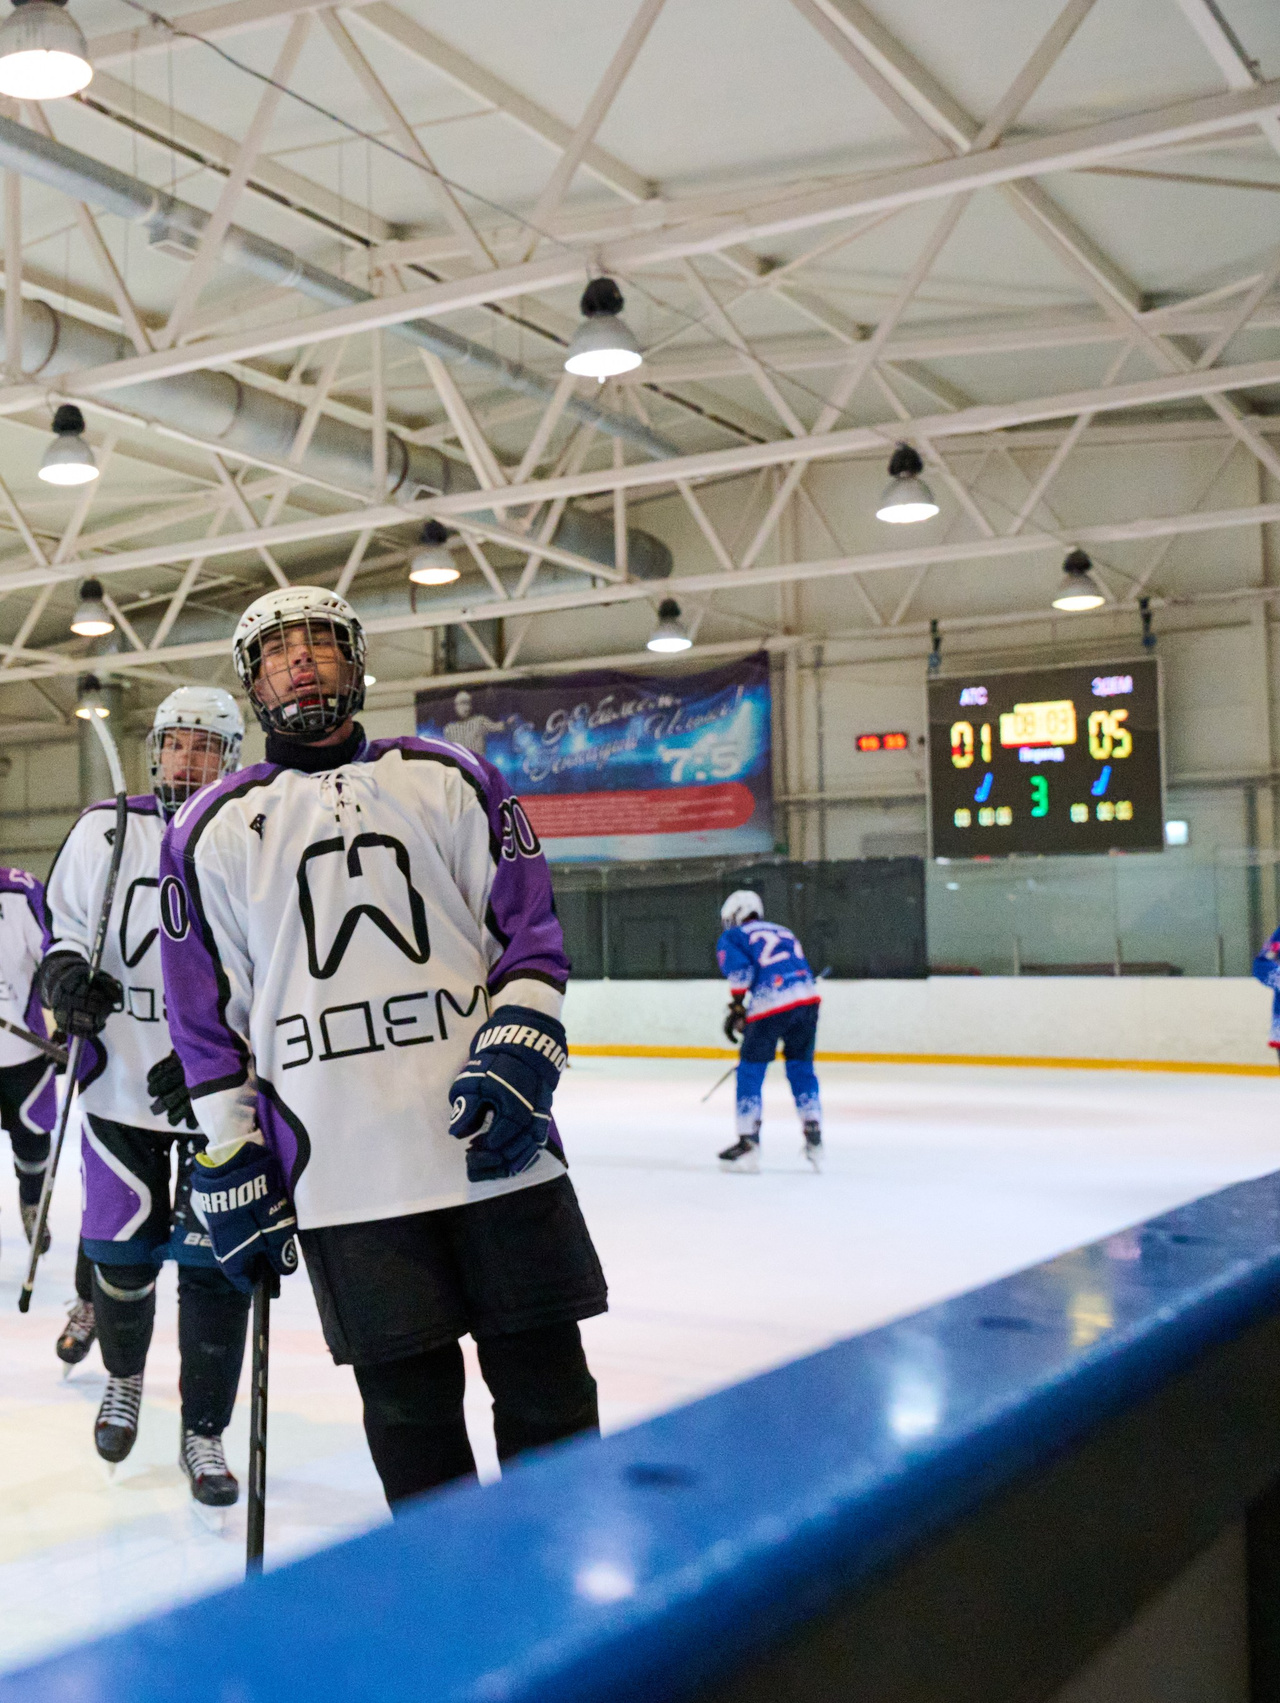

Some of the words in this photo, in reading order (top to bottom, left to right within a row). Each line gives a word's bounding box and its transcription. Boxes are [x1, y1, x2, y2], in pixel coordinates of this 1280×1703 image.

[1088, 708, 1133, 760] 05
[1030, 775, 1049, 818] 3
[275, 984, 490, 1071] ЭДЕМ
[474, 1023, 568, 1073] WARRIO
[200, 1173, 269, 1214] RRIOR
